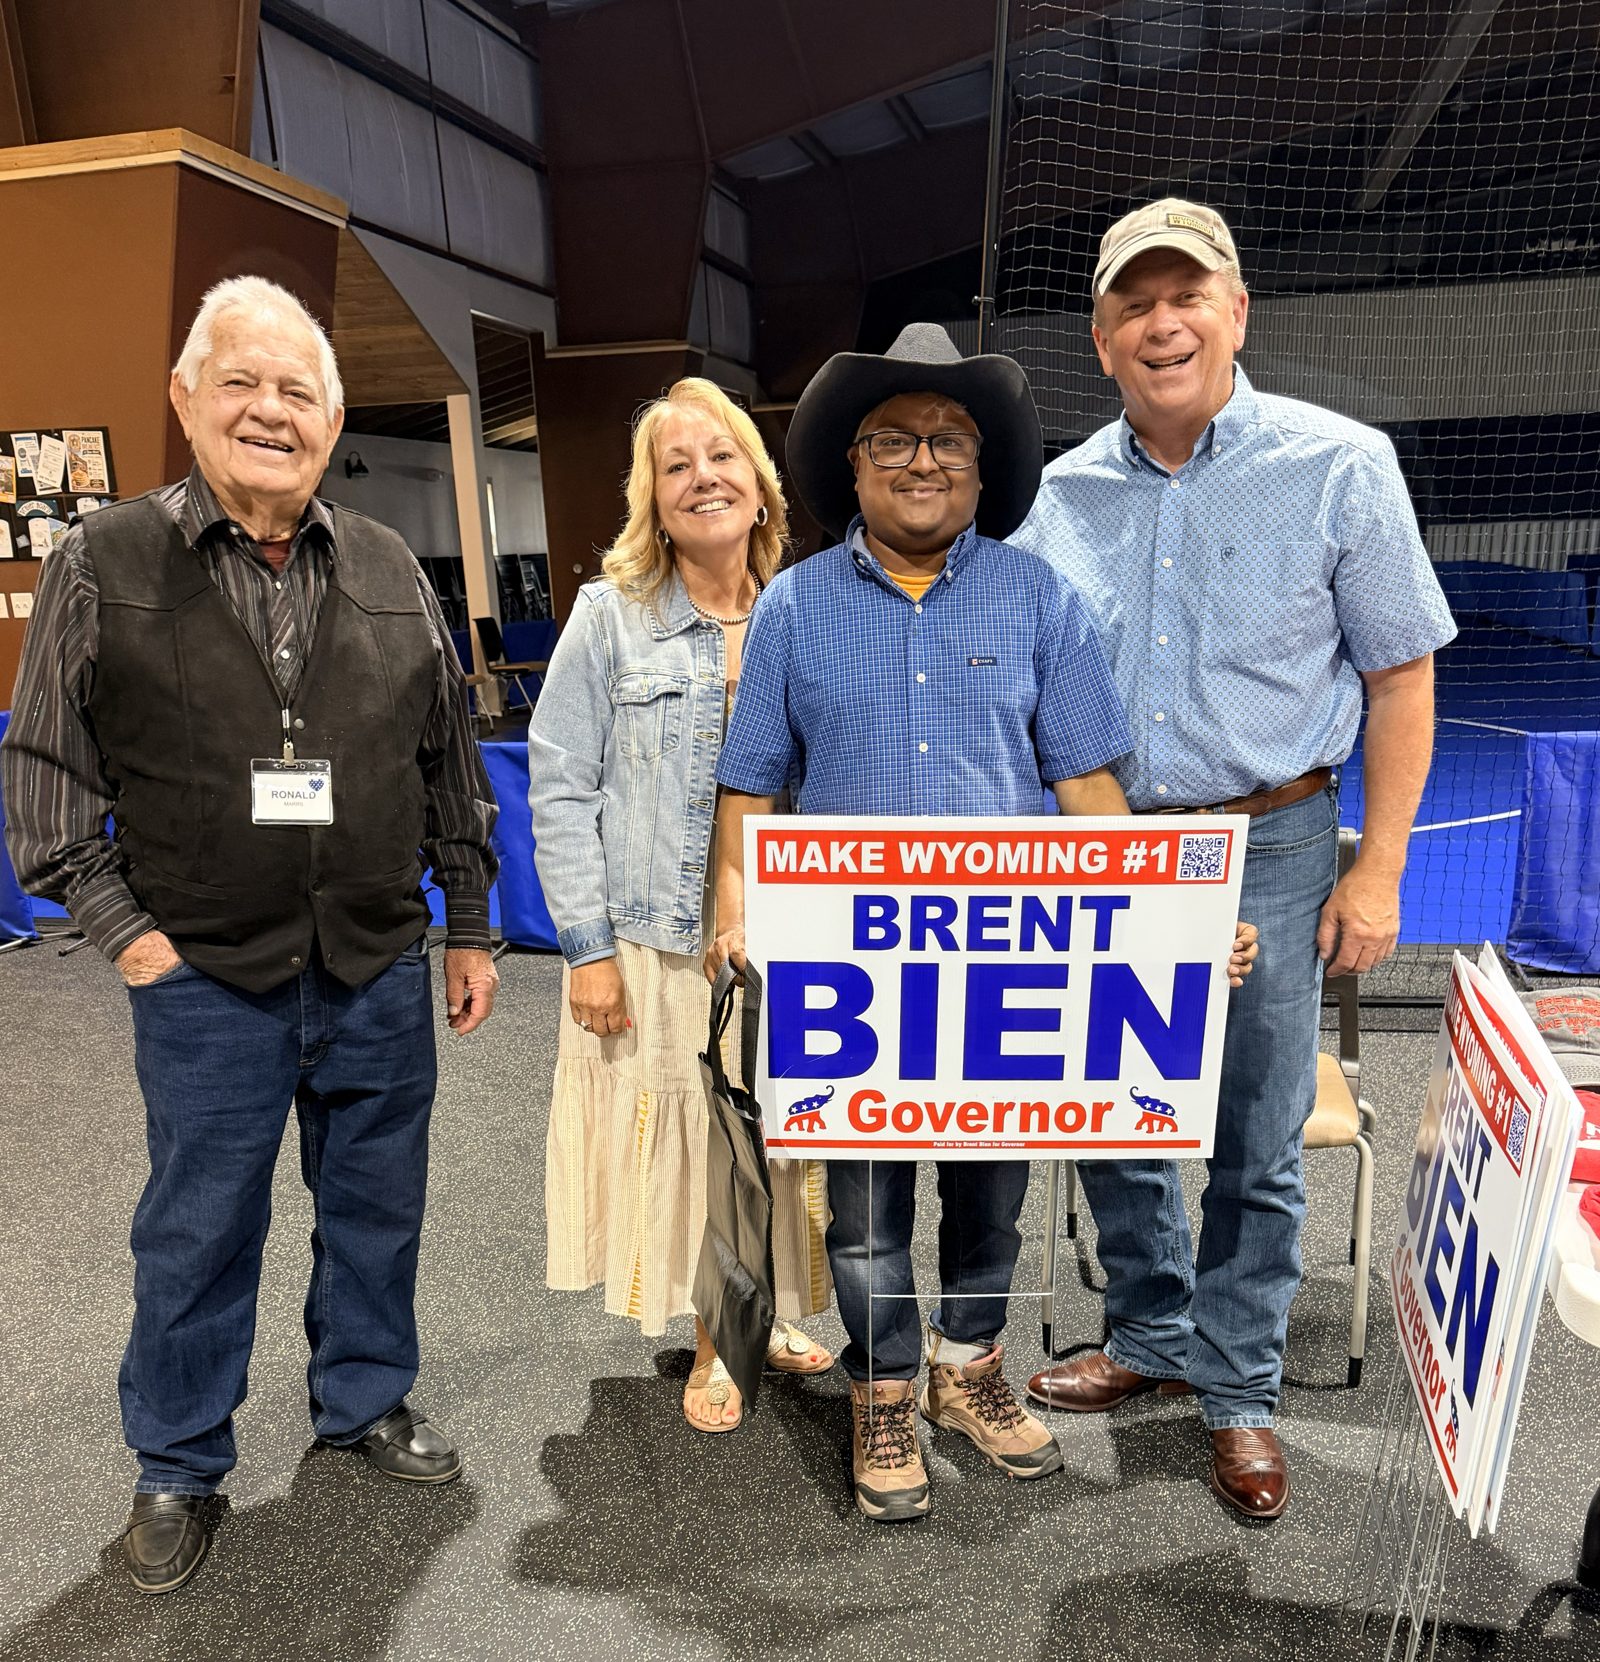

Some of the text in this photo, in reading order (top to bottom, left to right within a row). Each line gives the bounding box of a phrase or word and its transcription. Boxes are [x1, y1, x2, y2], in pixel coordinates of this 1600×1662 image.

[271, 790, 316, 800] RONALD
[765, 840, 1169, 874] MAKE WYOMING #1
[852, 894, 1132, 952] BRENT
[767, 960, 1212, 1081] BIEN
[1535, 996, 1577, 1008] BRENT
[1537, 1018, 1562, 1031] AKE
[1458, 1015, 1497, 1109] WYOMING
[1494, 1084, 1512, 1135] #1
[847, 1088, 1115, 1134] Governor
[1406, 1102, 1501, 1412] BIEN
[1399, 1247, 1447, 1414] Governor
